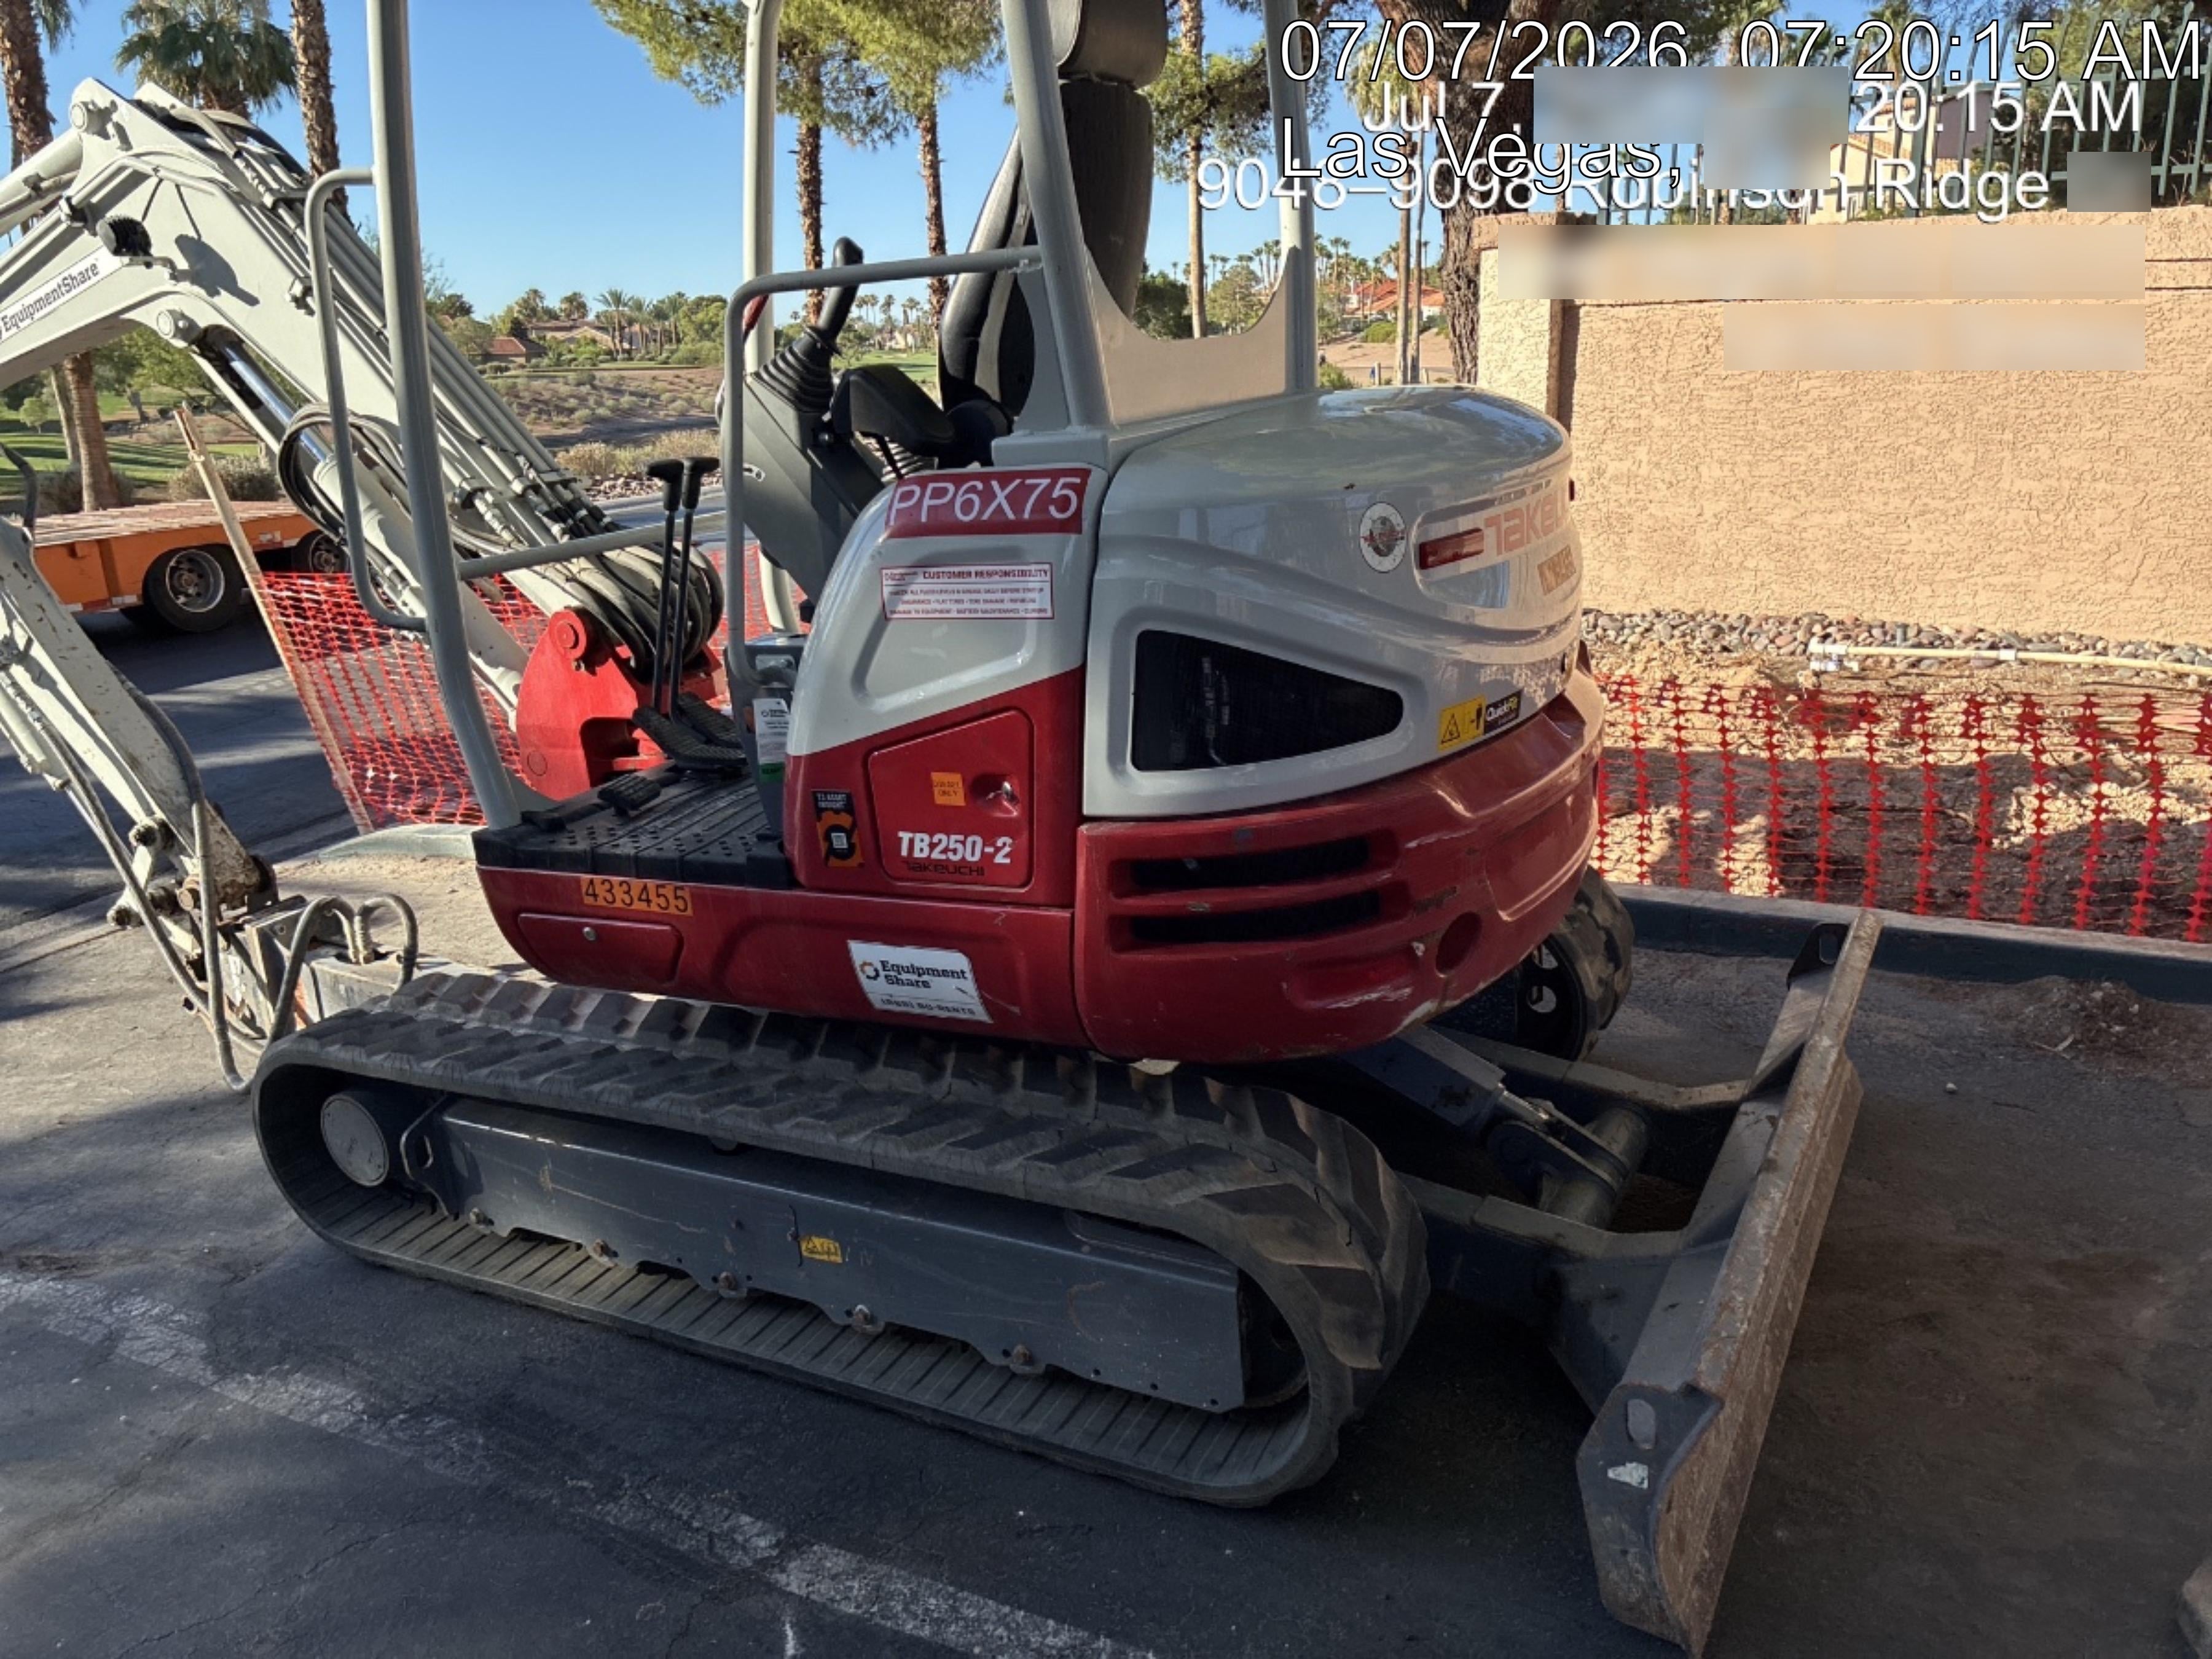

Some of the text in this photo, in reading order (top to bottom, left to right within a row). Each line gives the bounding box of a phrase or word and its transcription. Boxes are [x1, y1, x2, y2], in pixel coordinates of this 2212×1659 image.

[1, 262, 100, 332] EquipmentShare
[888, 477, 1081, 527] PP6X75
[898, 831, 1013, 863] TB250-2
[585, 877, 688, 913] 433455
[880, 960, 969, 981] Equipment
[885, 974, 932, 989] Share
